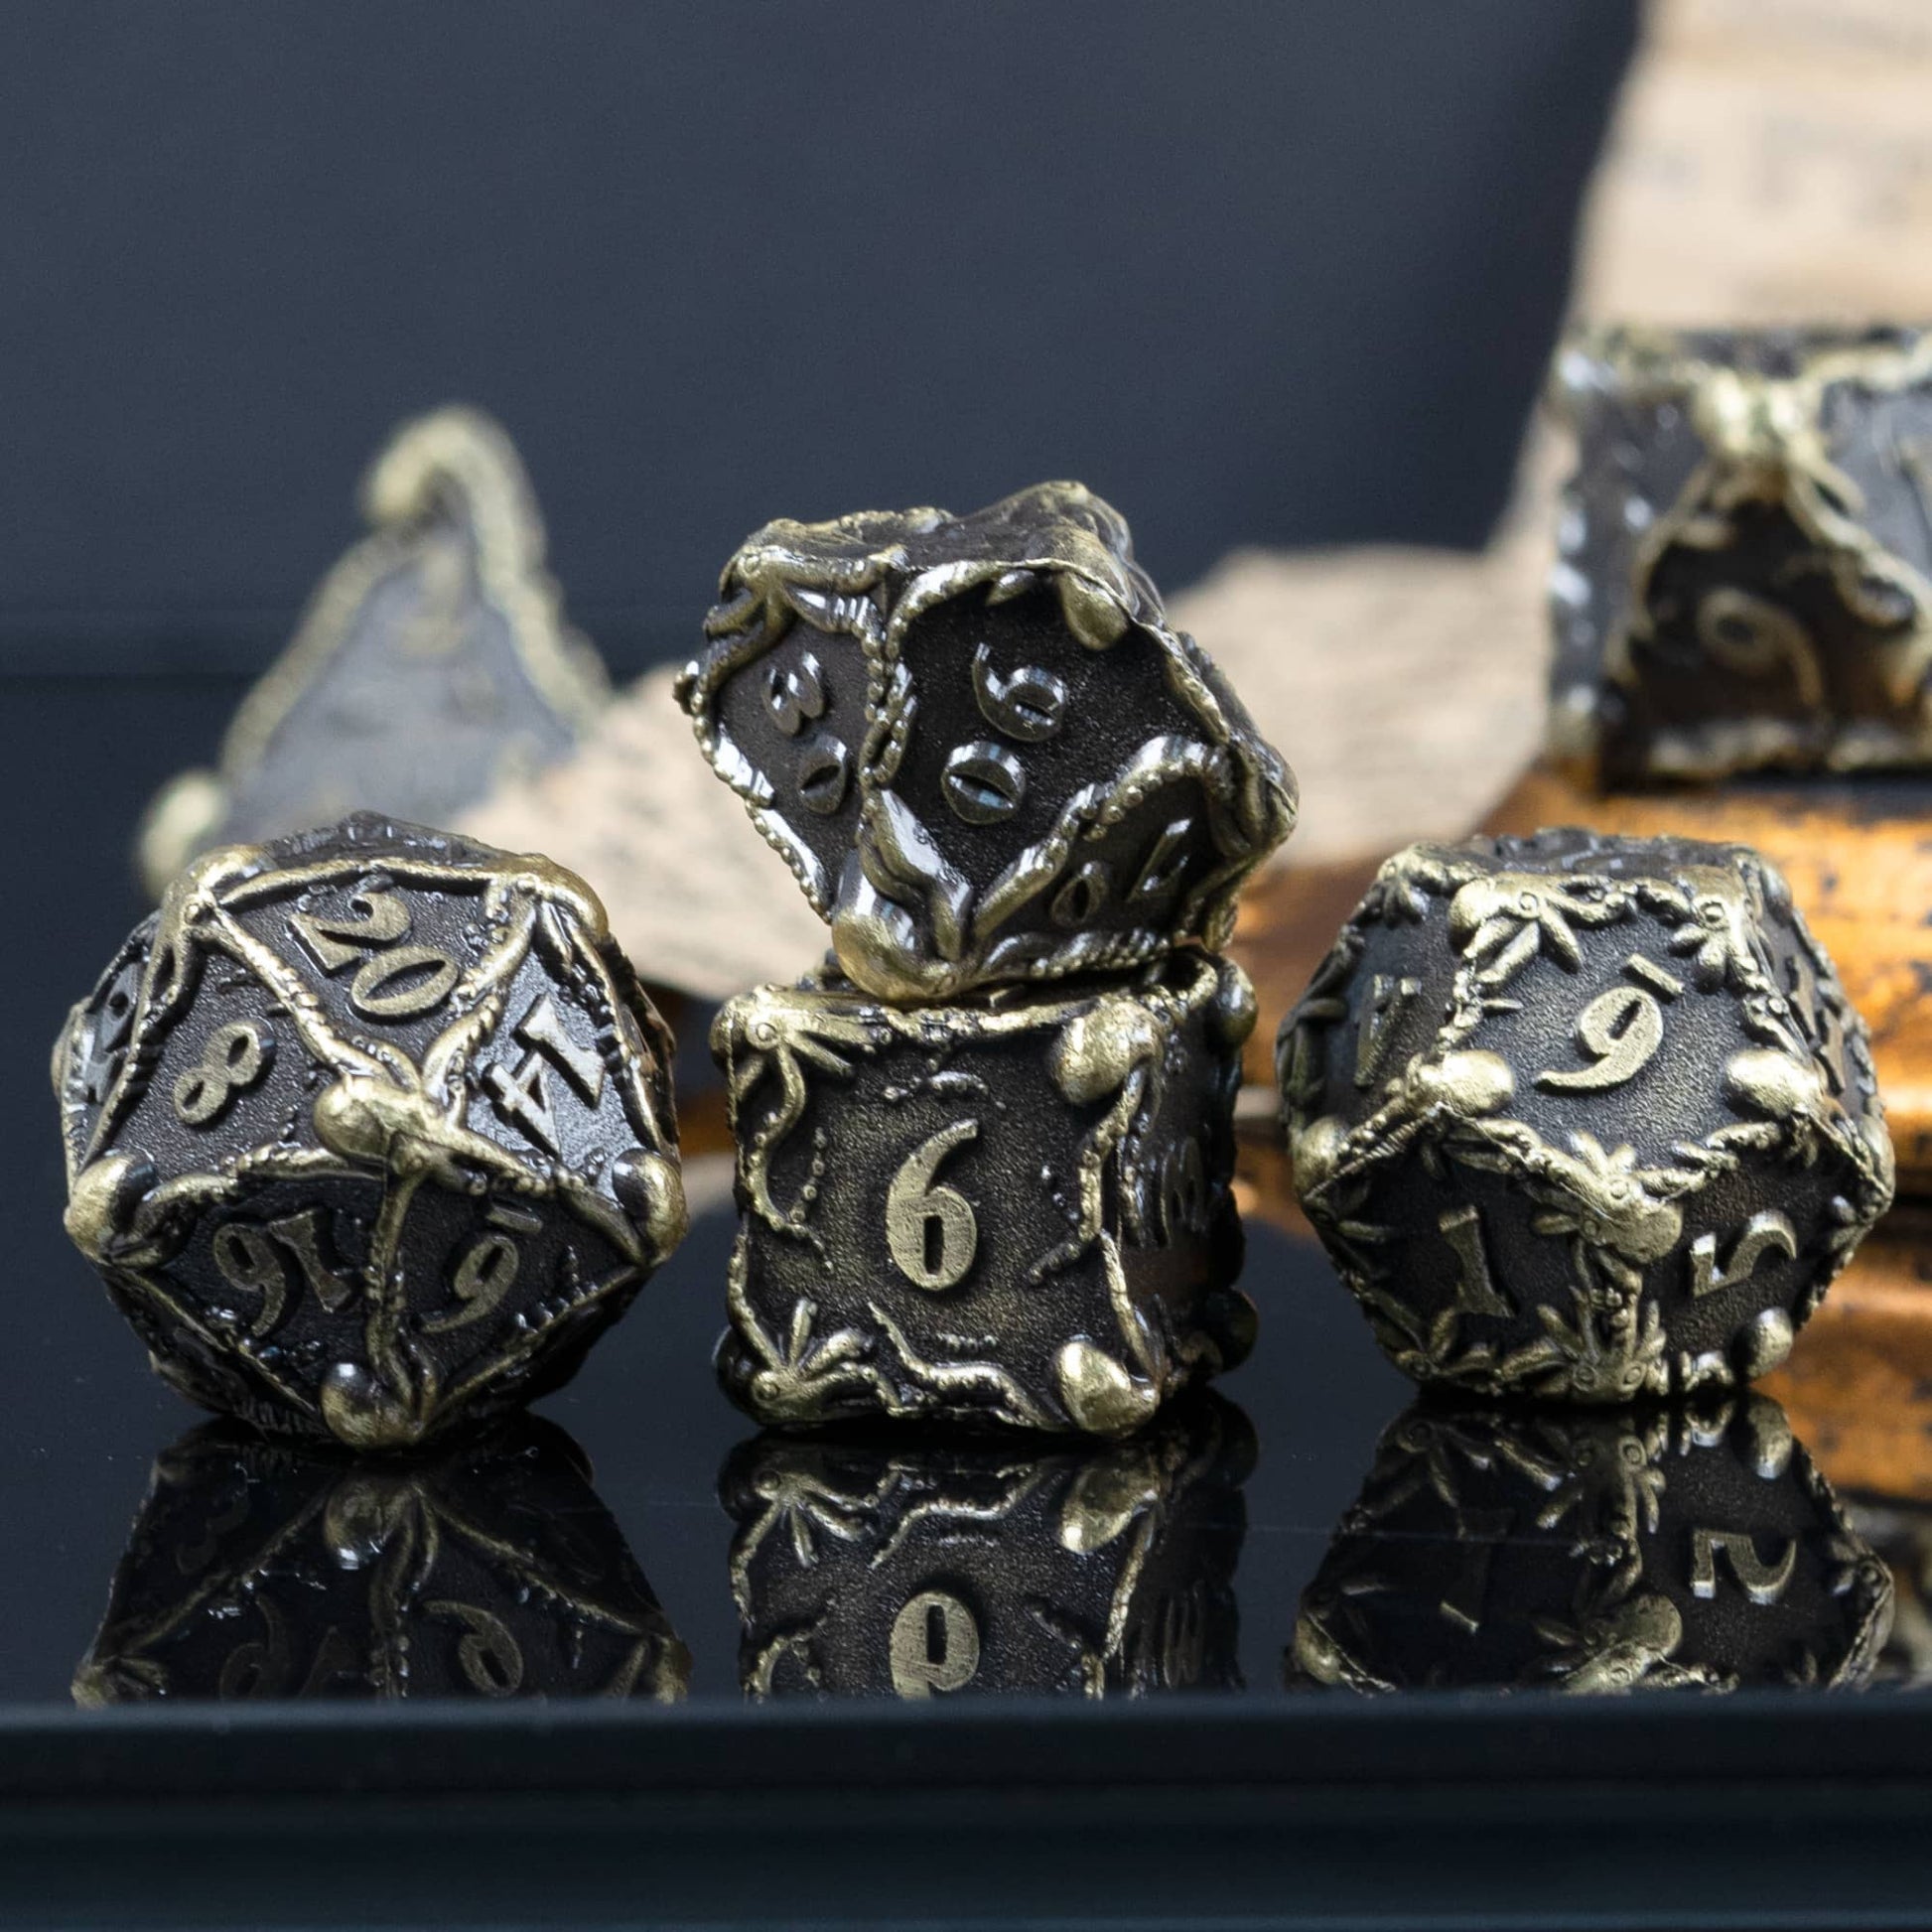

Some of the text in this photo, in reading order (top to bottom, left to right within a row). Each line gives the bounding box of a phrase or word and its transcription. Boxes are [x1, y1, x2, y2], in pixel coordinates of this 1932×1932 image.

[286, 880, 460, 1018] 20
[173, 1021, 271, 1125] 8
[483, 994, 607, 1160] 14
[887, 1118, 978, 1291] 6
